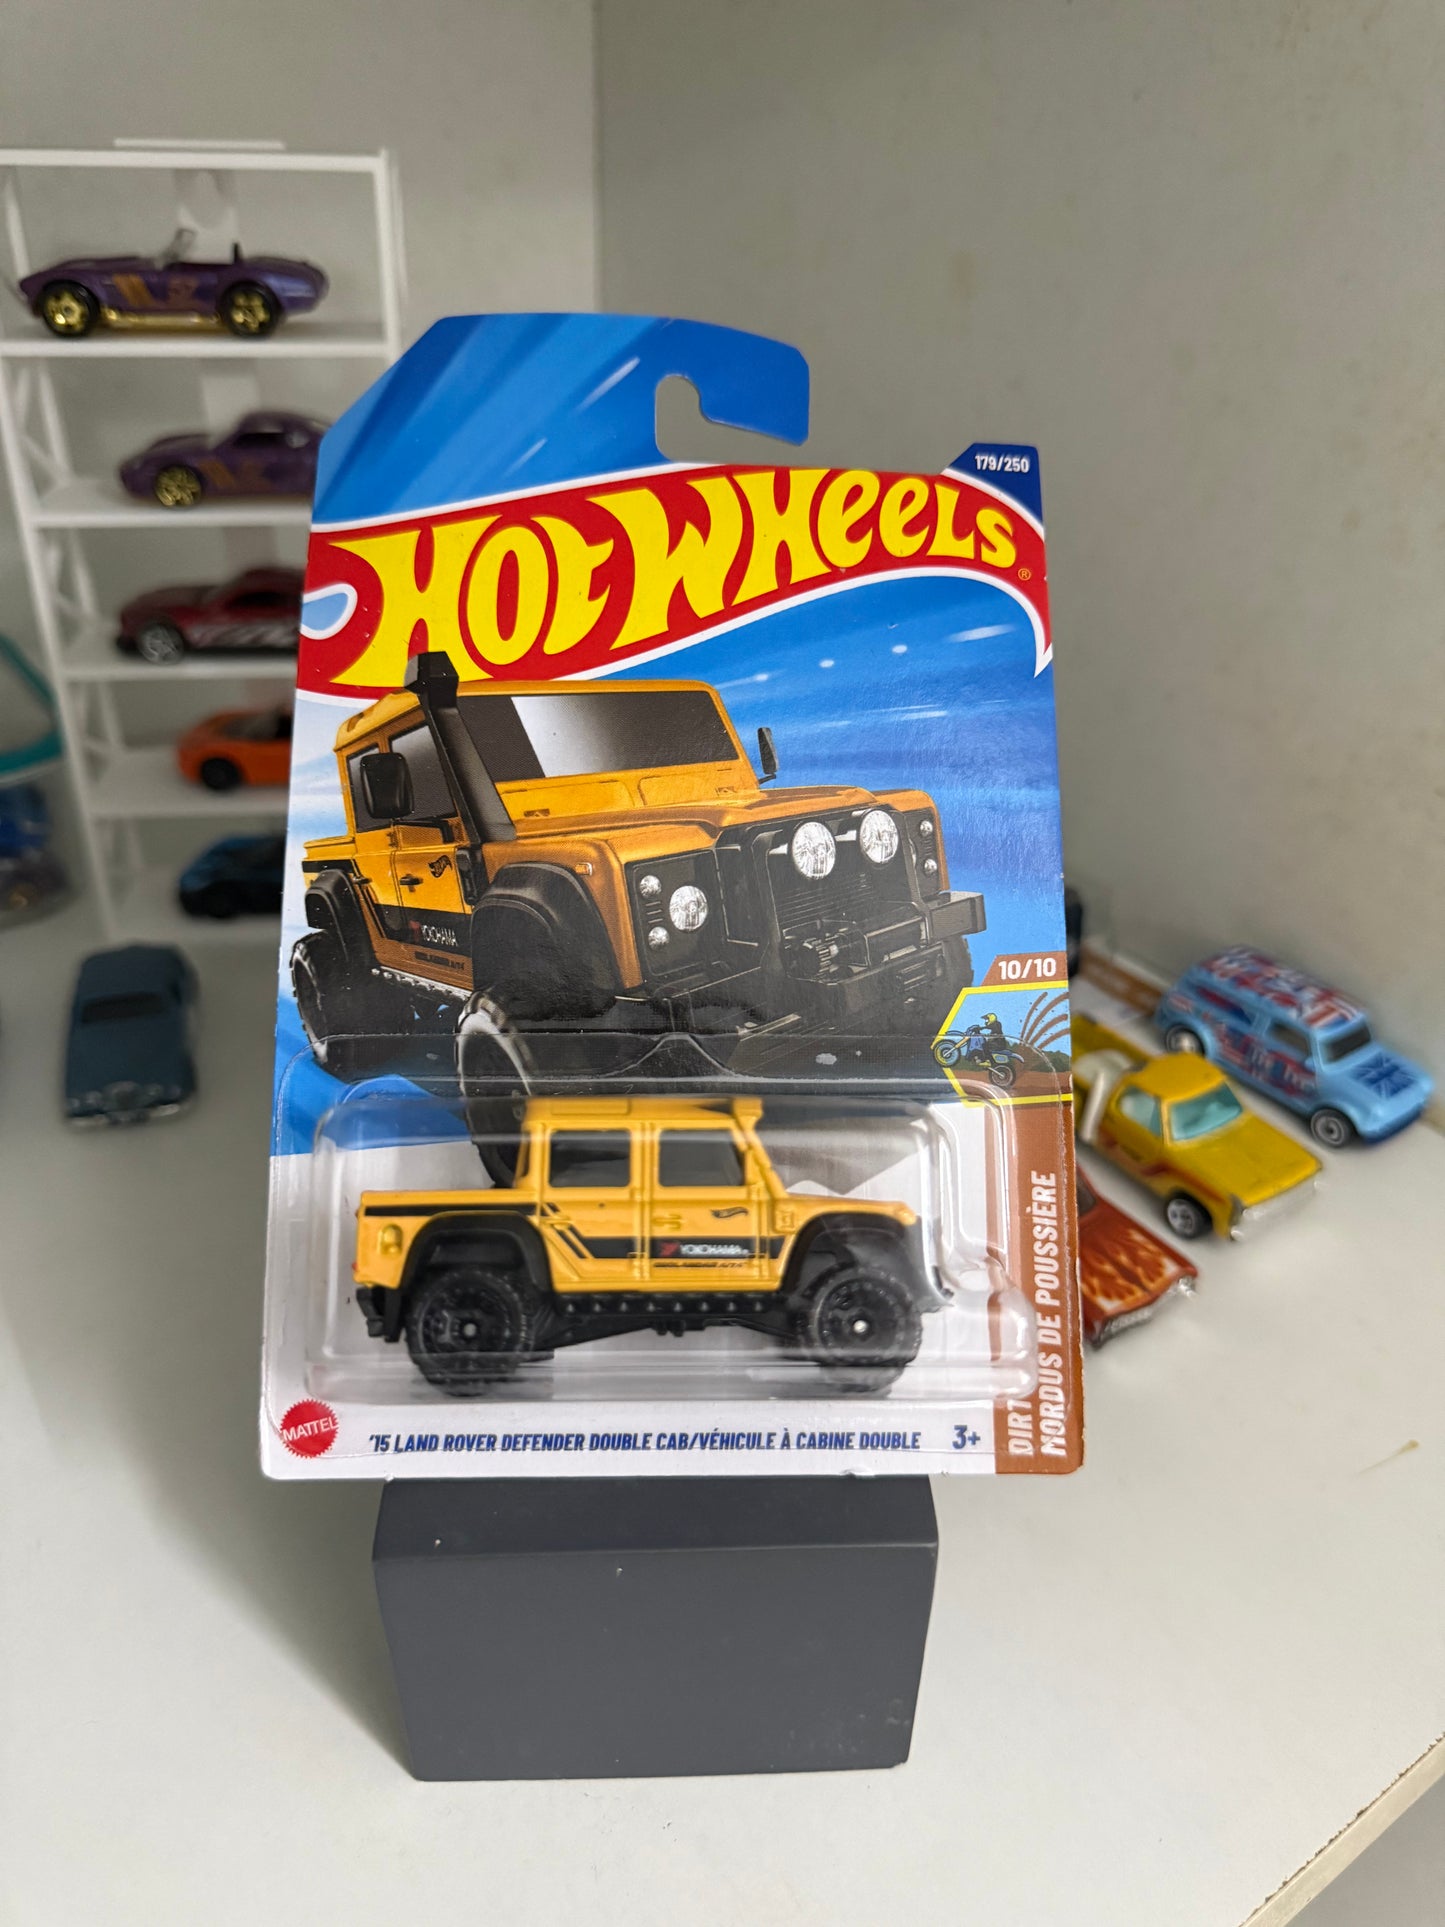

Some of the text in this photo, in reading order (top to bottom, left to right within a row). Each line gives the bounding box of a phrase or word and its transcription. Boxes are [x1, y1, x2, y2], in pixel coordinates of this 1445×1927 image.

[975, 454, 1030, 474] 179/250
[998, 957, 1056, 980] 10/10
[1026, 1170, 1067, 1456] MORDUS DE POUSSIÈRE
[283, 1416, 339, 1442] MATTEL
[394, 1433, 439, 1452] LAND
[443, 1433, 497, 1452] ROVER
[501, 1432, 585, 1452] DEFENDER
[589, 1431, 652, 1451] DOUBLE
[656, 1428, 777, 1451] CAB/VÉHICULE
[780, 1427, 791, 1450] À
[799, 1431, 855, 1450] CABINE
[859, 1431, 922, 1450] DOUBLE
[953, 1424, 981, 1450] 3+
